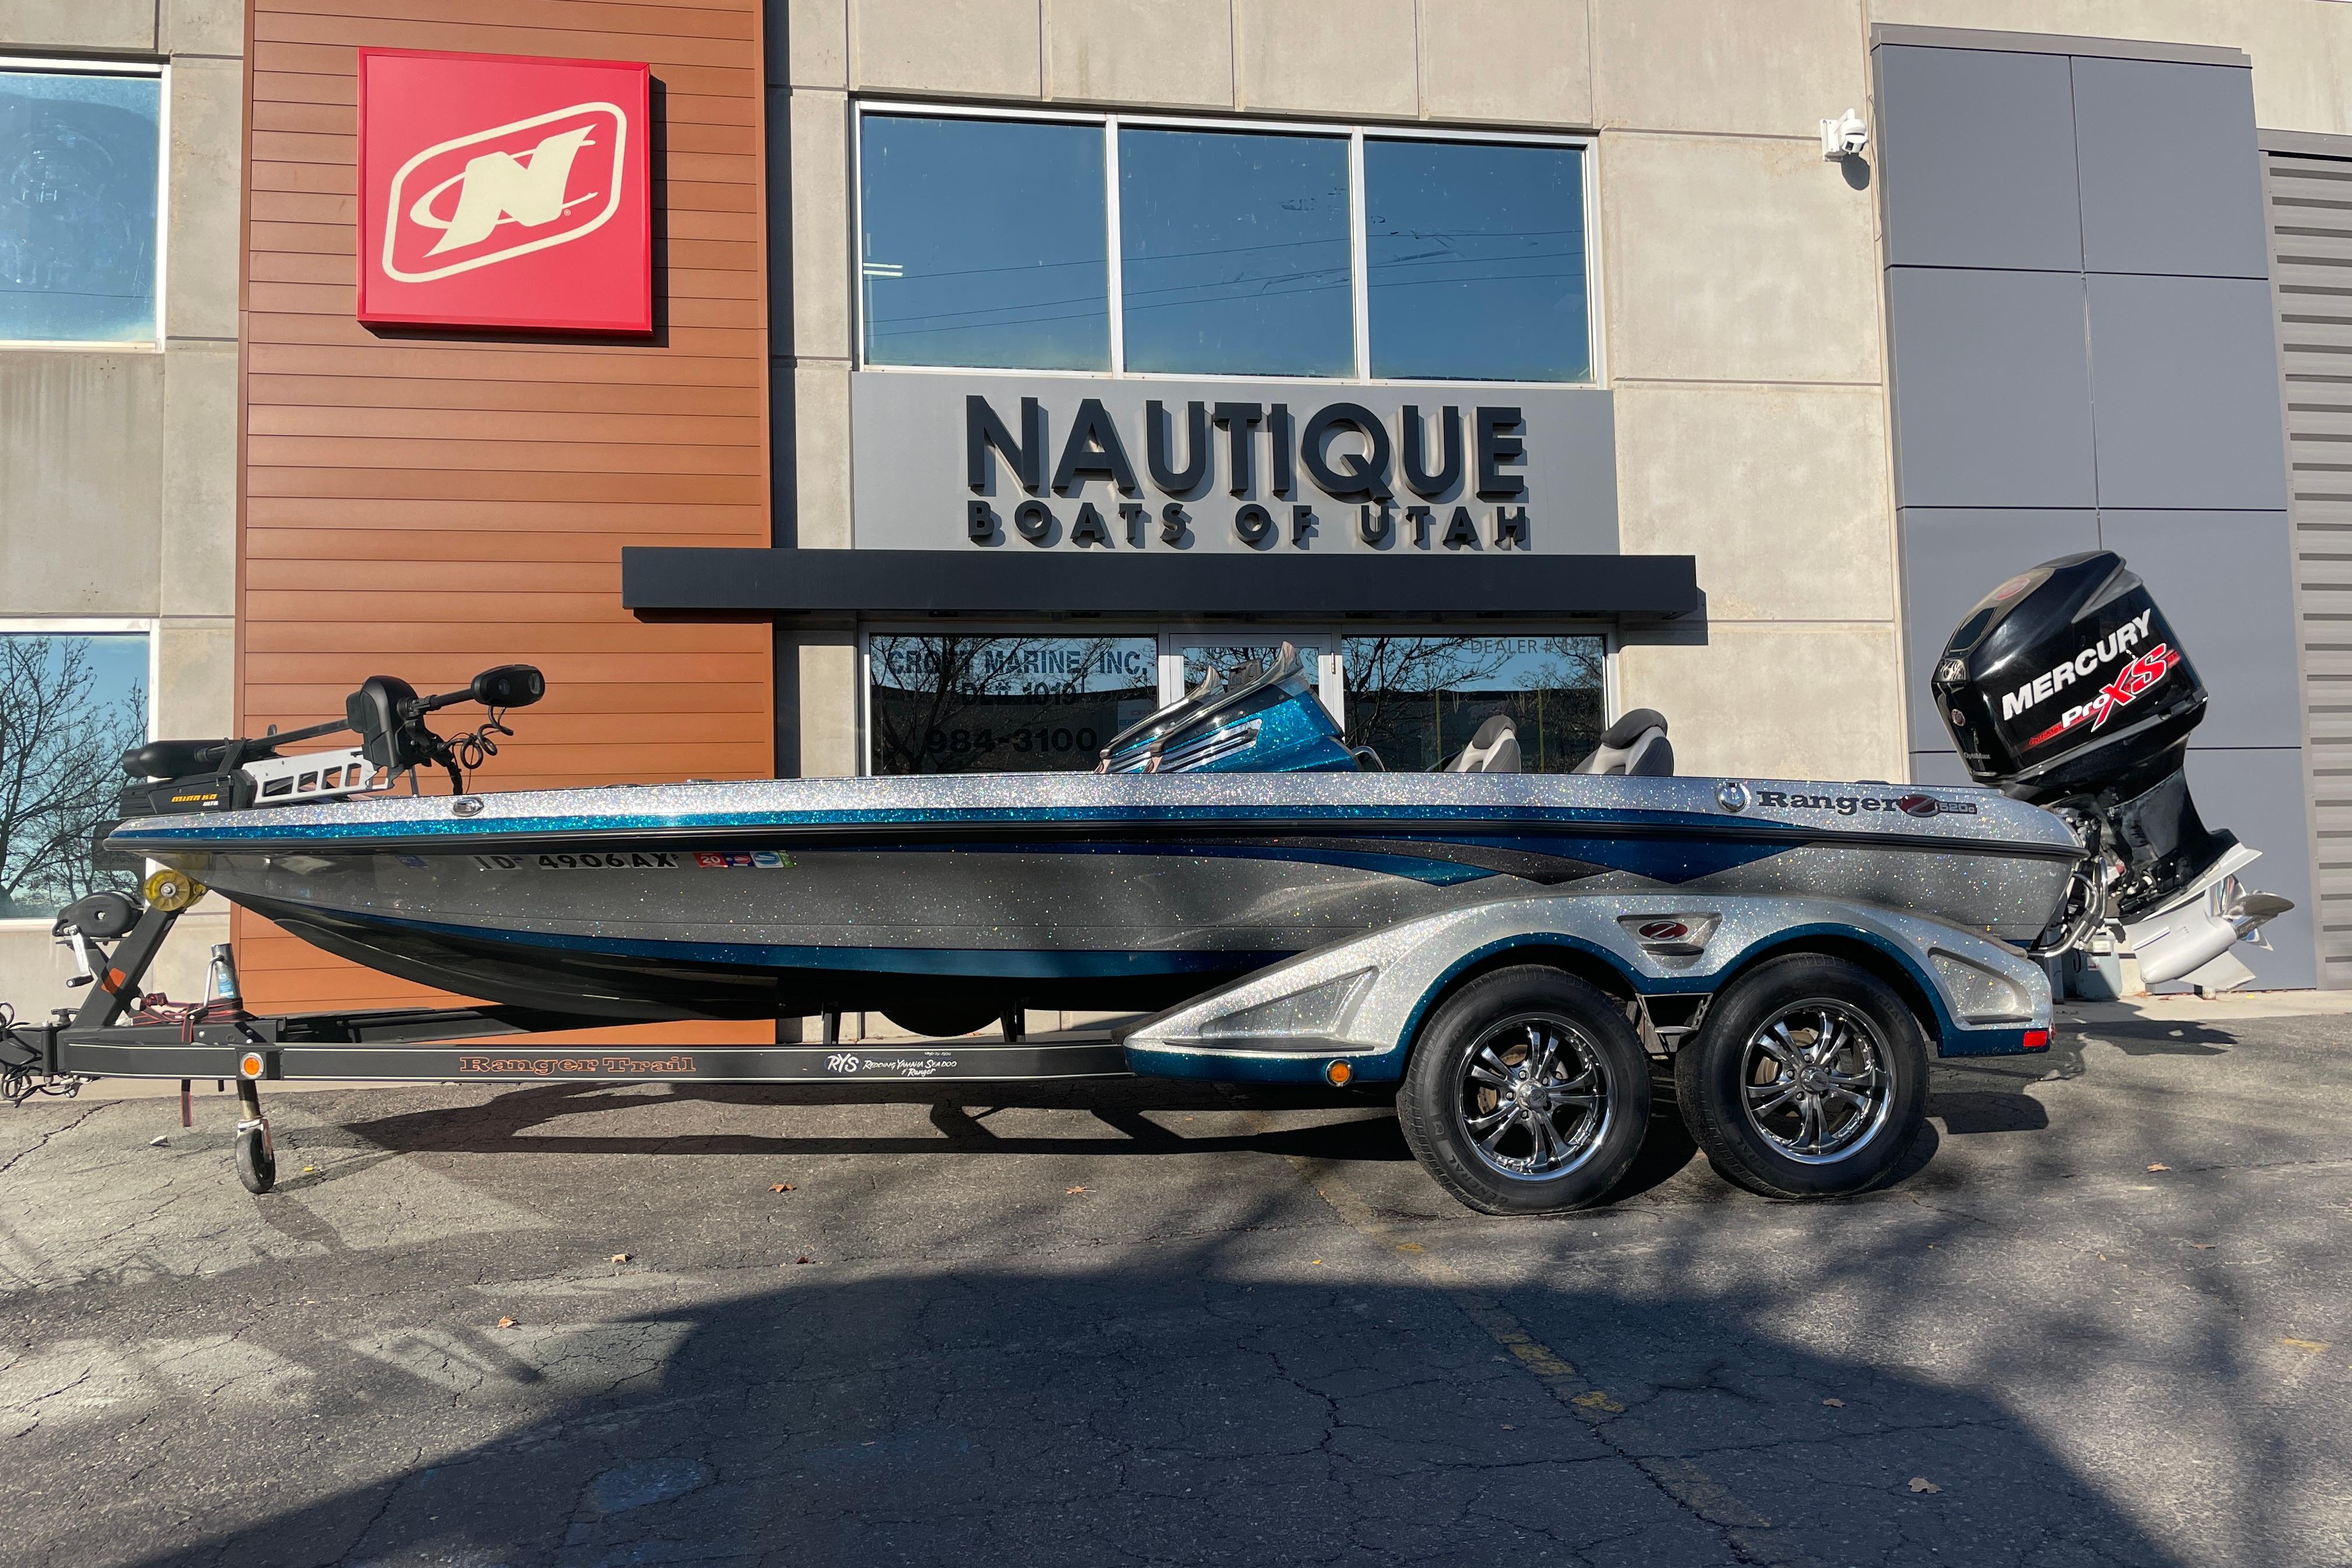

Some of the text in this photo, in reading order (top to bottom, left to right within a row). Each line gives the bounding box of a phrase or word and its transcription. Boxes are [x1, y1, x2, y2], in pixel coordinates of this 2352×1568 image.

[966, 394, 1525, 502] NAUTIQUE
[967, 499, 1526, 546] BOATS OF UTAH
[1471, 639, 1538, 654] DEALER
[2001, 608, 2151, 721] MERCURY
[926, 727, 1098, 754] 984-3100
[1756, 790, 1901, 816] Ranger
[473, 855, 517, 869] ID
[700, 855, 721, 864] 20
[460, 1056, 696, 1075] Ranger Trail
[827, 1052, 859, 1073] RYS
[907, 1068, 936, 1077] Ranger
[1448, 1154, 1509, 1204] GENERAL
